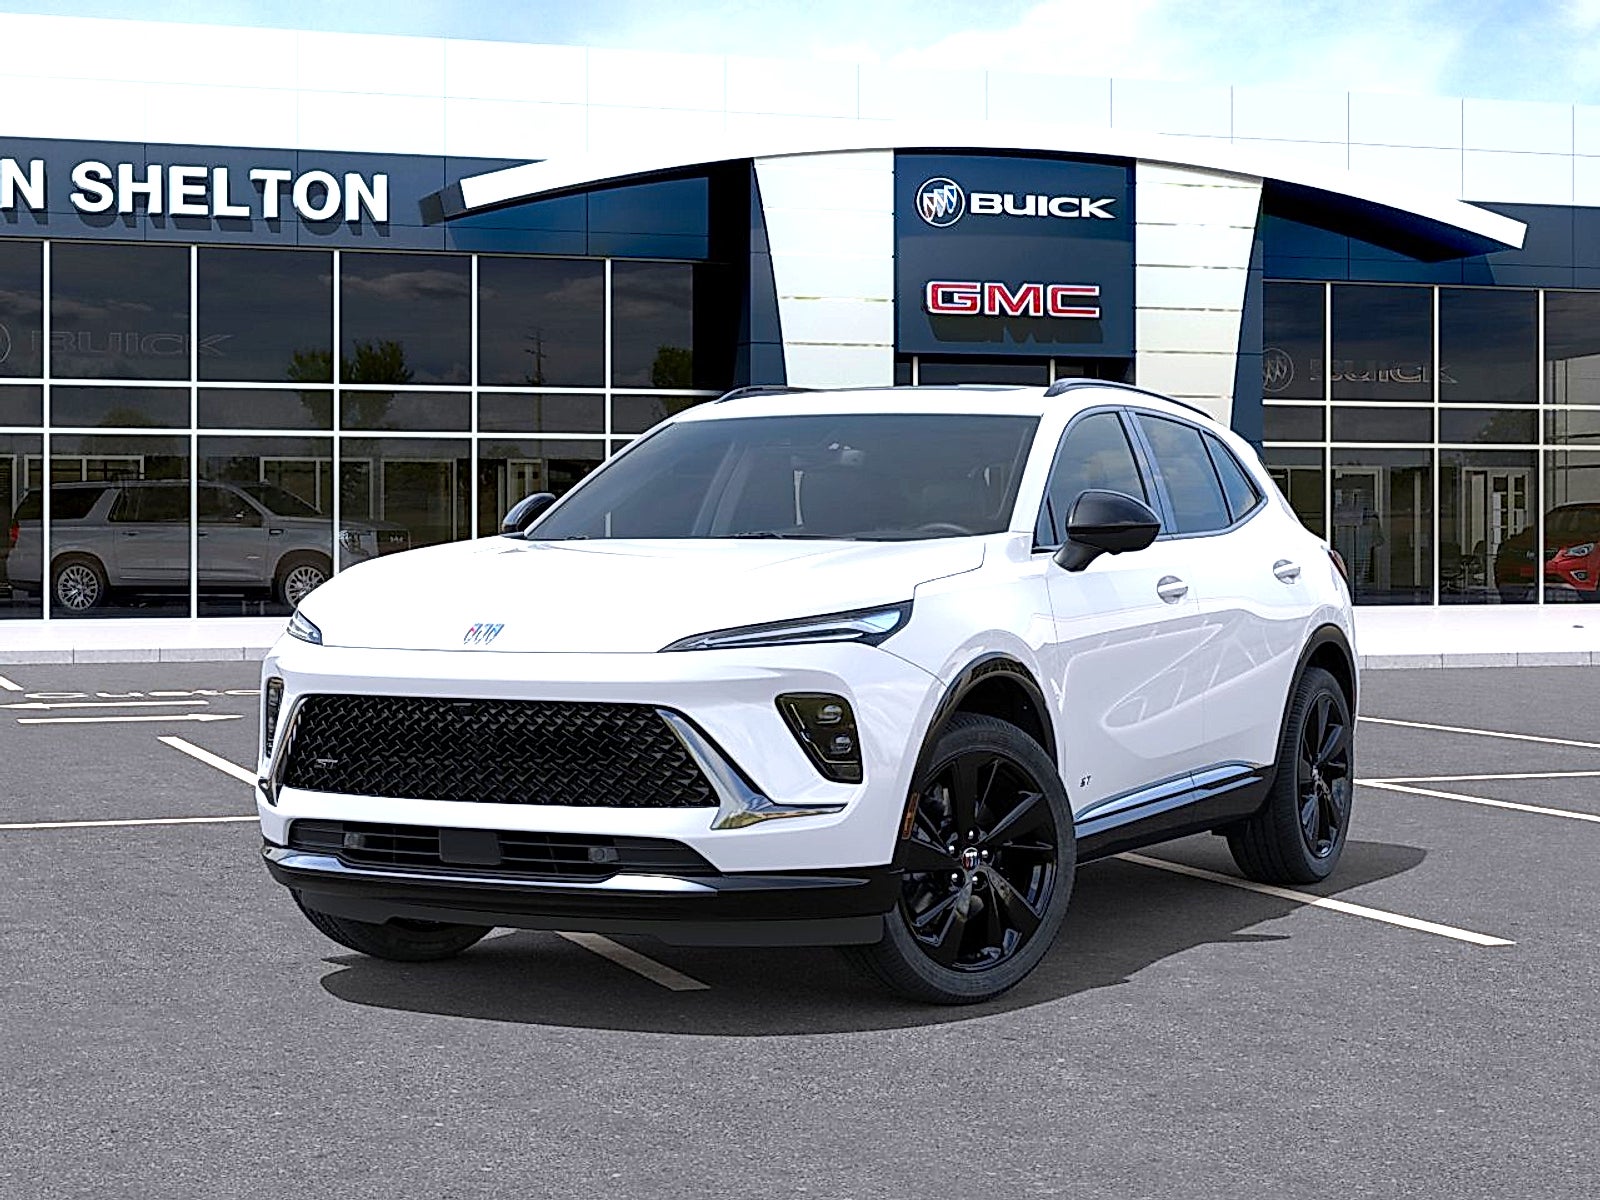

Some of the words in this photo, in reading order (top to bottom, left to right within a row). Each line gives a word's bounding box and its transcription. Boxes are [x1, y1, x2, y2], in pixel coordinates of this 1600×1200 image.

[70, 160, 389, 222] SHELTON
[970, 192, 1117, 219] BUICK
[926, 280, 1101, 319] GMC
